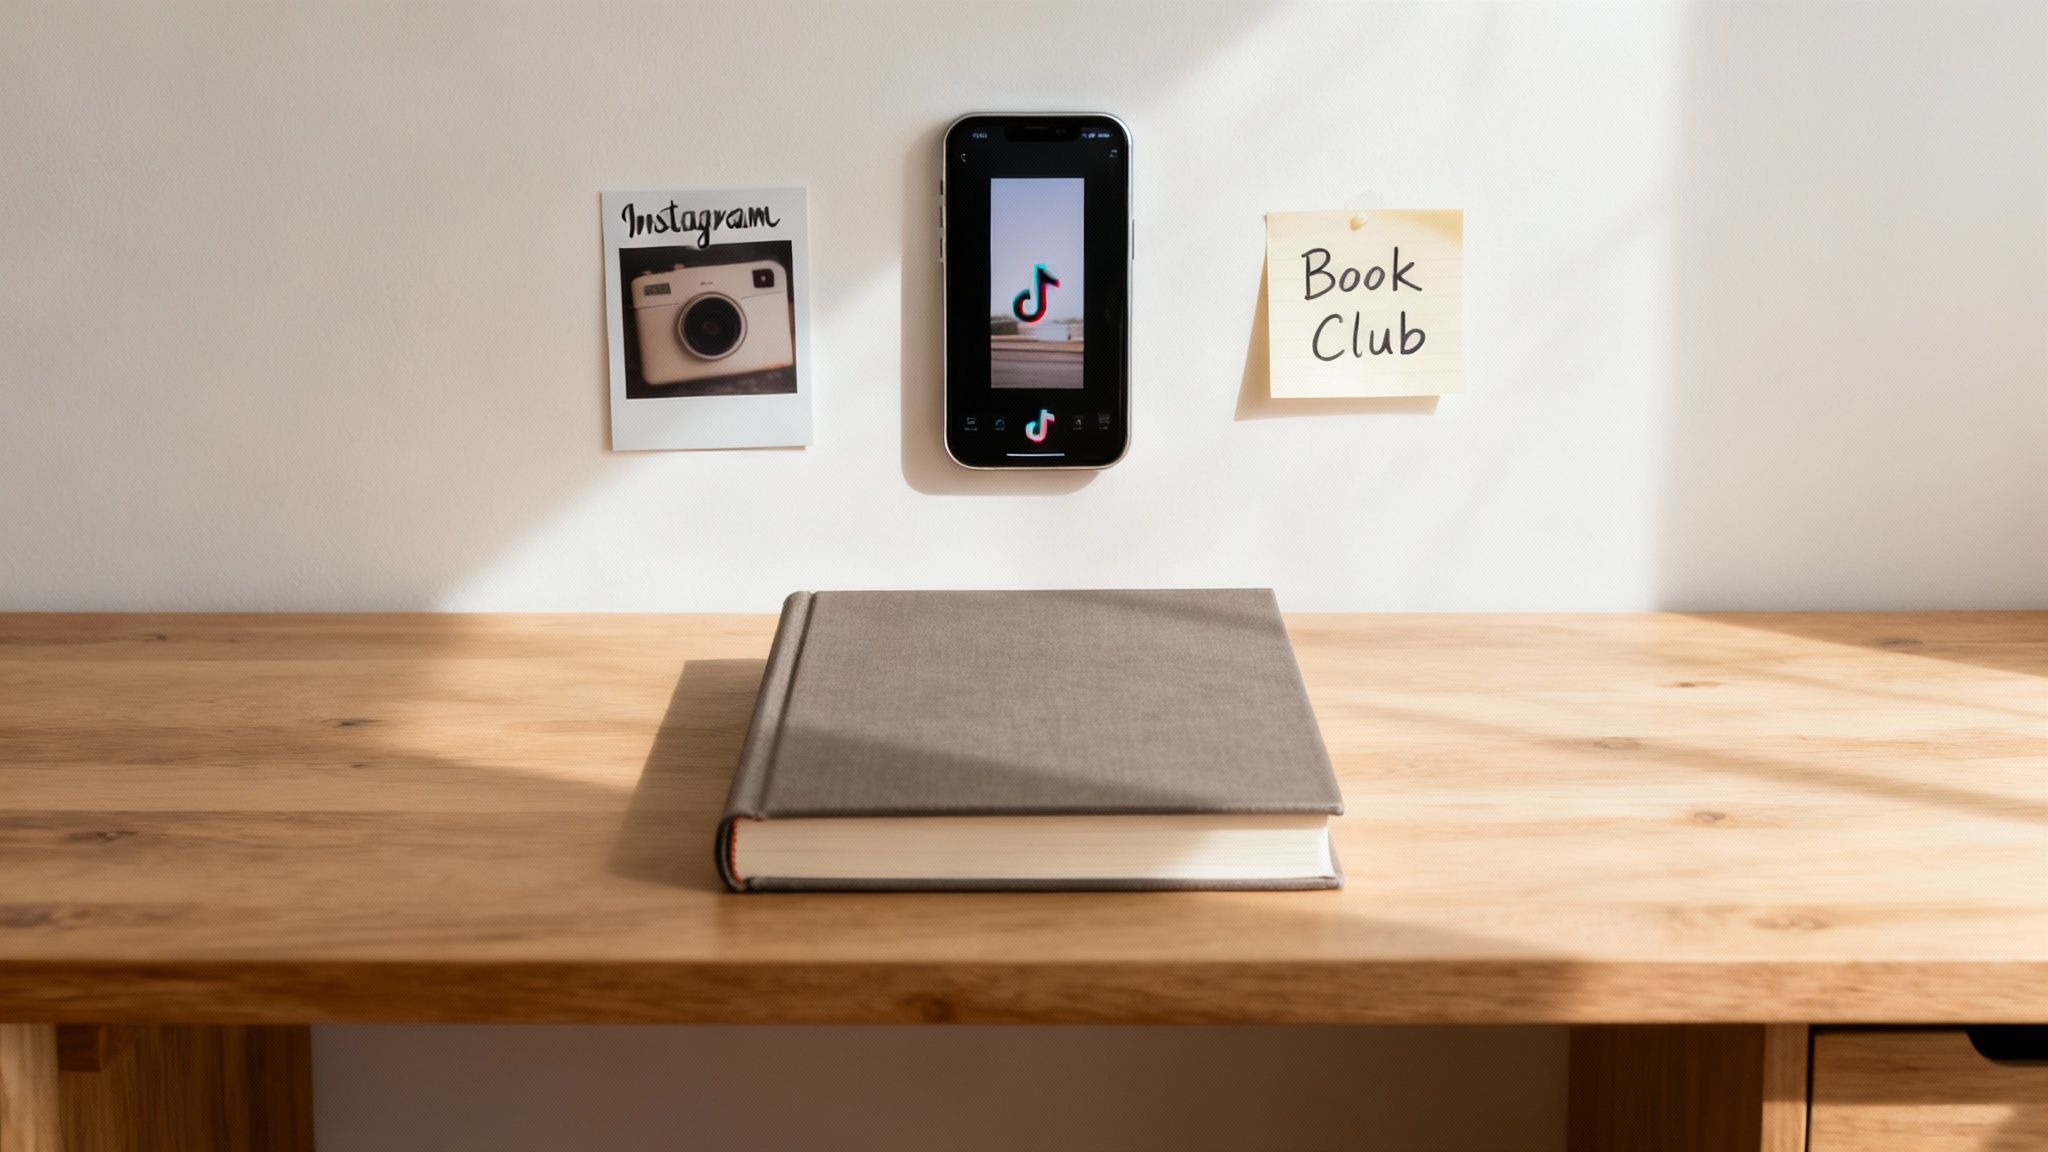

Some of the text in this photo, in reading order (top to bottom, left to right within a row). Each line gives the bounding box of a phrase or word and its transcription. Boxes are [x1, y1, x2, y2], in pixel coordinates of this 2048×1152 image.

[621, 200, 781, 249] Instagram
[1301, 246, 1423, 301] Book
[1312, 310, 1426, 362] Club
